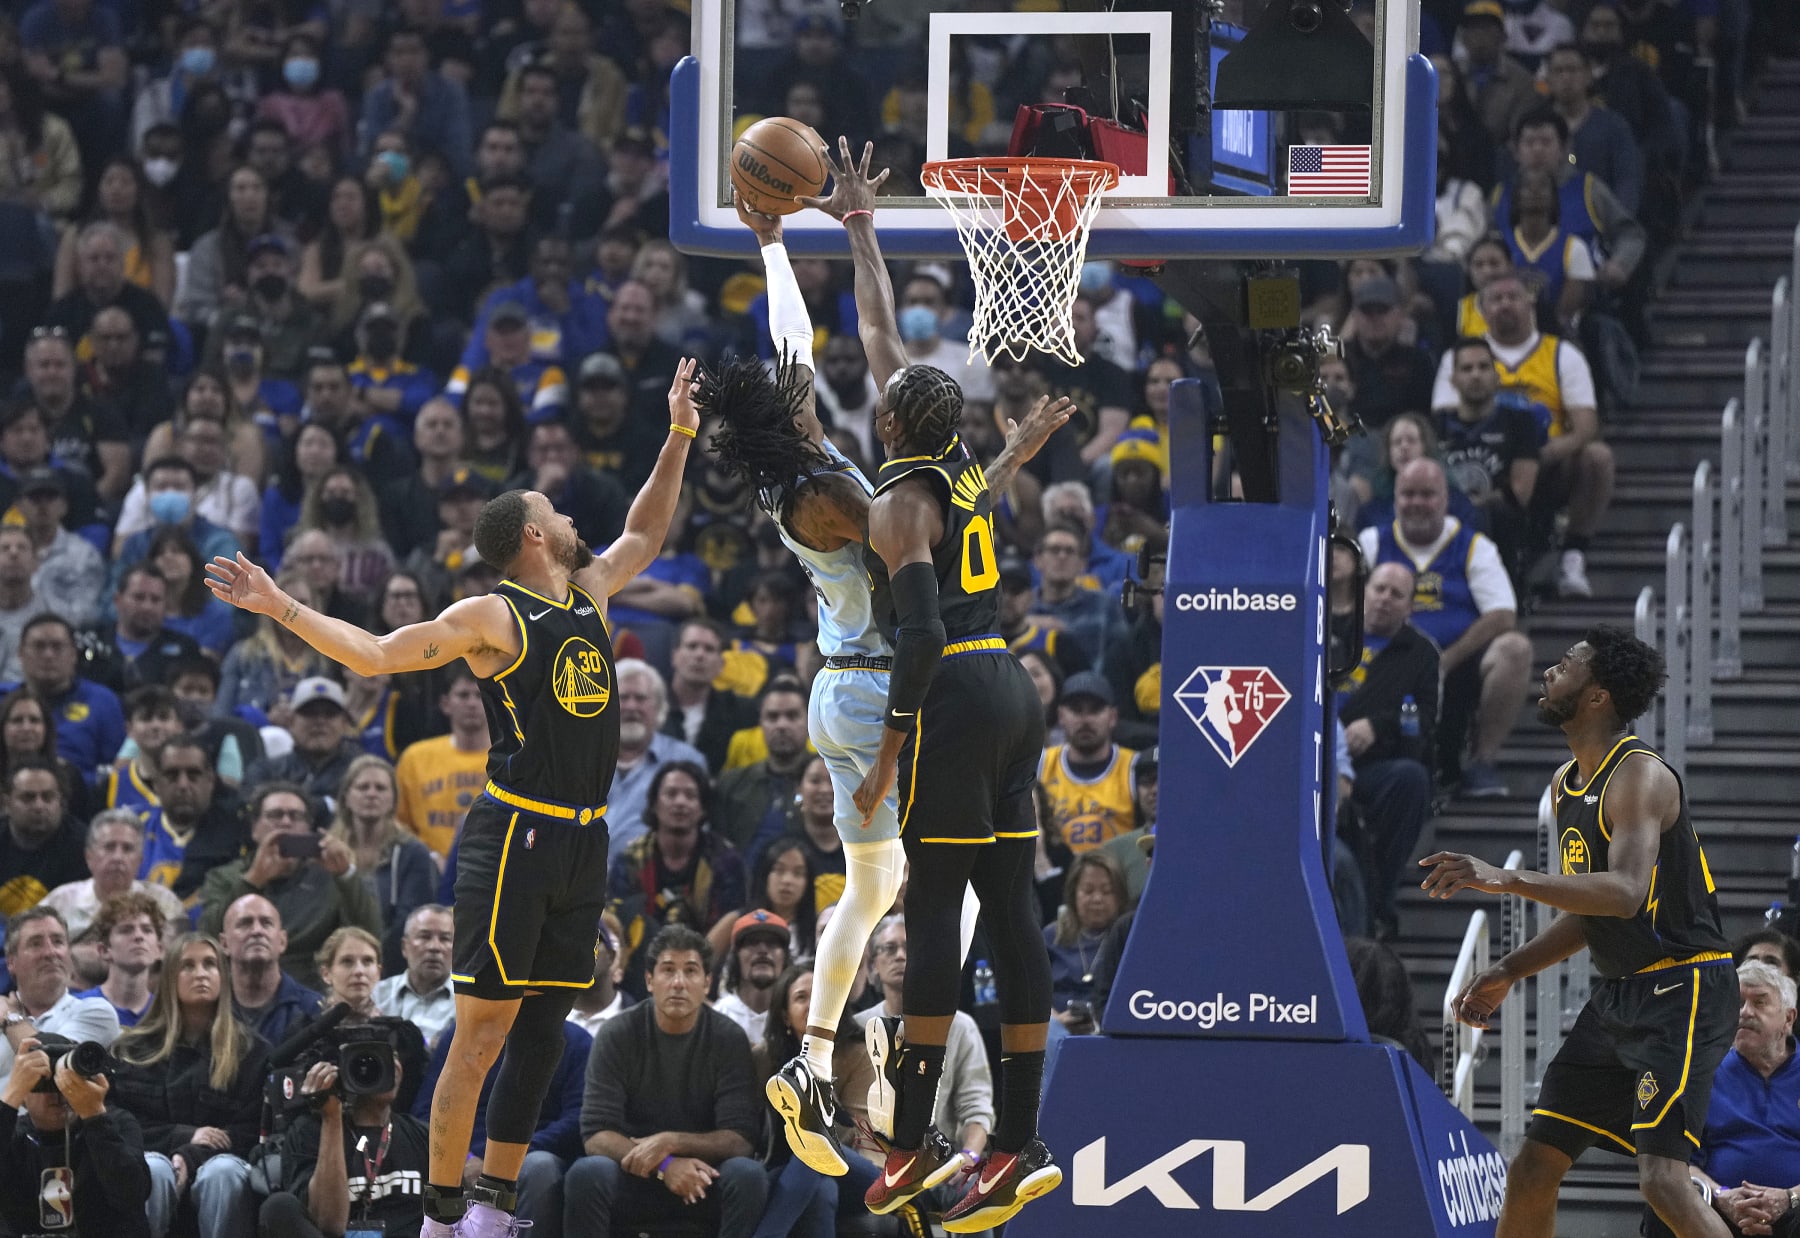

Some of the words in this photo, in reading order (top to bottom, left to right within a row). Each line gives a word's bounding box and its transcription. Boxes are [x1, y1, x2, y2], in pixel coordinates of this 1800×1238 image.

[738, 150, 794, 194] Wilson
[1175, 587, 1297, 611] coinbase
[1314, 535, 1327, 706] NBA
[578, 651, 601, 673] 30
[1242, 681, 1264, 710] 75
[1312, 730, 1322, 841] TV
[1070, 821, 1103, 844] 23
[1568, 839, 1584, 863] 22
[1128, 989, 1241, 1029] Google
[1249, 992, 1317, 1024] Pixel
[348, 1170, 422, 1202] ESPN
[1072, 1135, 1370, 1216] KIA
